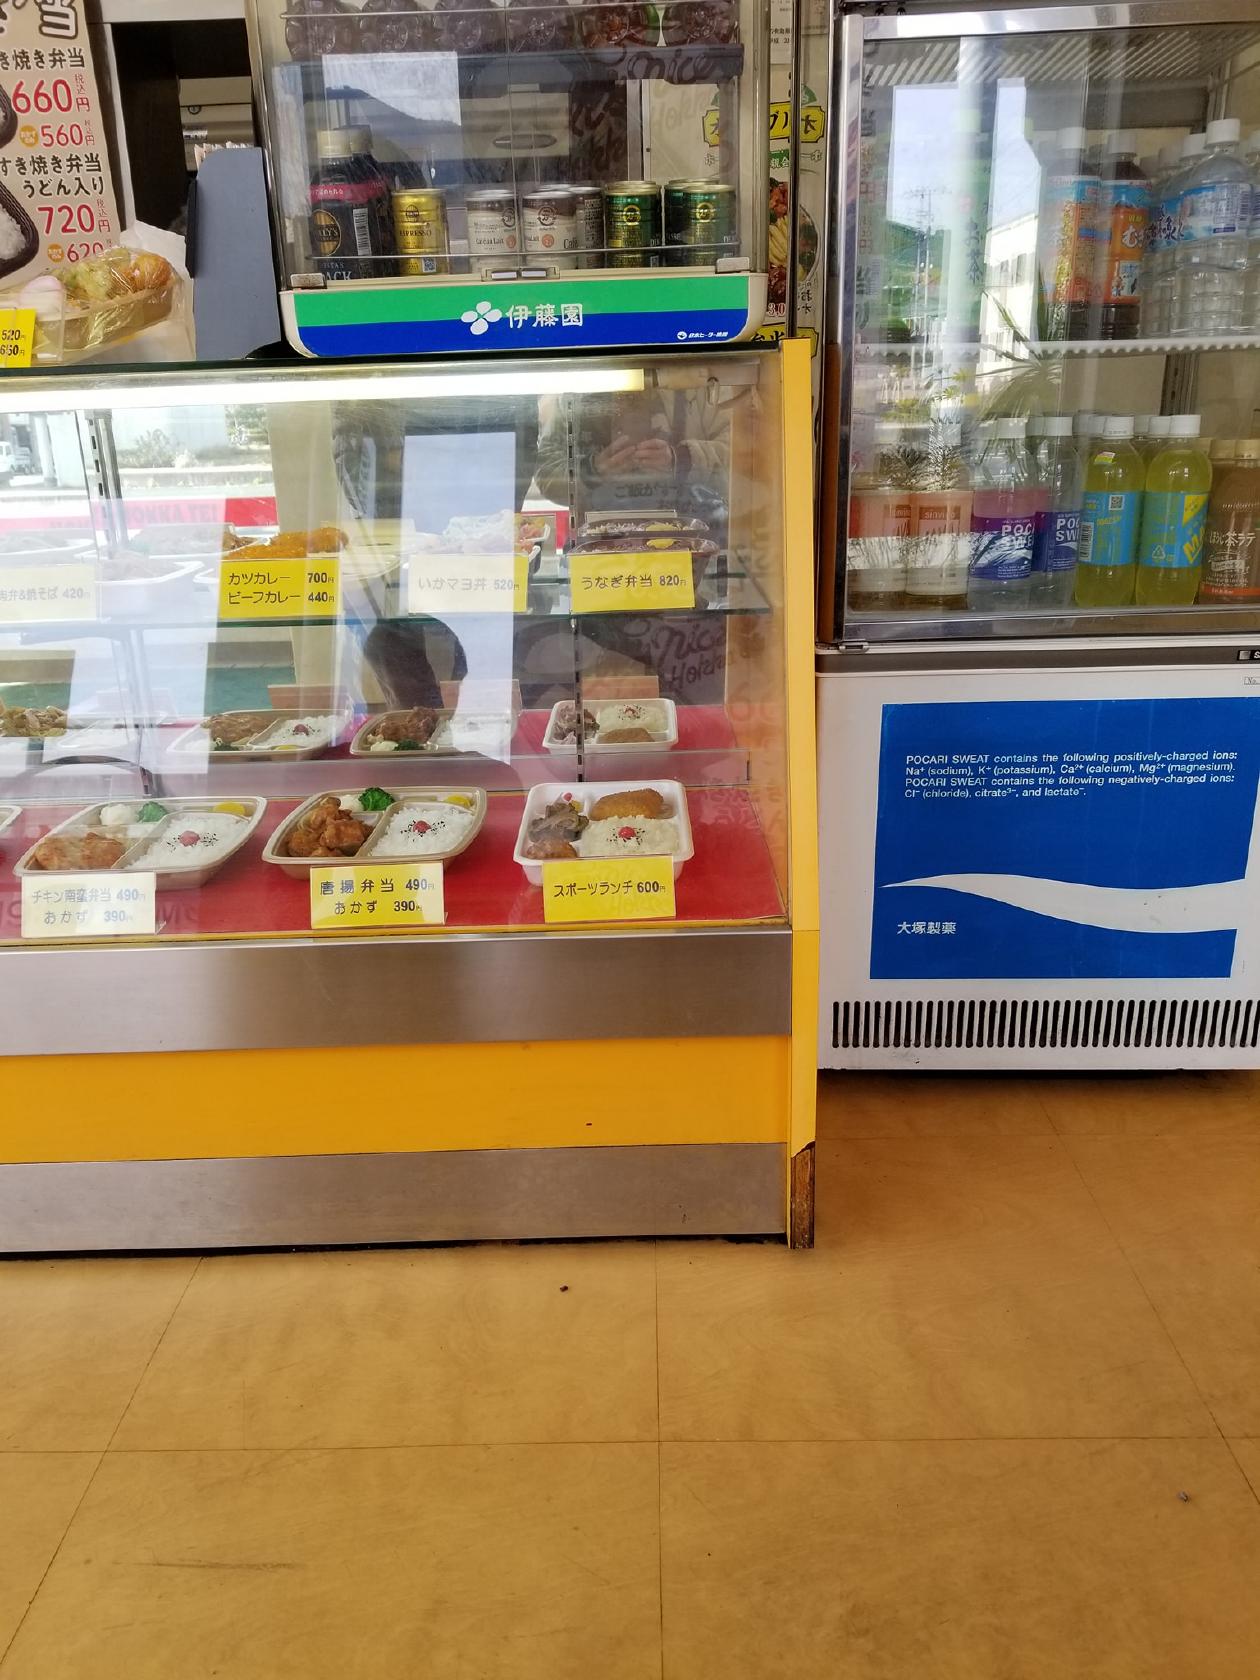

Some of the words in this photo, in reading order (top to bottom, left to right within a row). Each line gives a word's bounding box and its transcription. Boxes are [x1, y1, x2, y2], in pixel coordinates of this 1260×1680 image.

[12, 78, 73, 114] 660
[40, 123, 84, 147] 560
[23, 176, 105, 199] うどん入り
[37, 204, 96, 235] 720
[506, 303, 583, 329] 伊藤園
[228, 572, 292, 586] カツカレー
[581, 573, 654, 590] うなぎ弁当
[228, 591, 302, 605] ビーフカレー
[906, 755, 948, 764] POCARI
[952, 754, 990, 764] SWEAT
[993, 754, 1038, 763] contains
[1042, 753, 1059, 762] the
[1063, 752, 1110, 764] following
[1114, 750, 1209, 763] positively-charged
[1212, 750, 1238, 760] ions:
[928, 766, 974, 777] (sodium),
[993, 764, 1056, 776] (potassium),
[1086, 764, 1136, 774] (calcium),
[1168, 762, 1236, 773] (magnesium).
[905, 778, 946, 787] POCARI
[950, 777, 988, 786] SWEAT
[991, 776, 1035, 786] contains
[1038, 776, 1054, 785] the
[1058, 775, 1105, 786] following
[1108, 774, 1207, 786] negatively-charged
[1210, 773, 1235, 783] ions:
[922, 788, 972, 799] (chloride),
[1022, 788, 1042, 798] and
[553, 880, 634, 898] スポーツランチ
[334, 900, 378, 916] おかず
[43, 910, 88, 925] おかず
[897, 921, 957, 935] 大塚製薬
